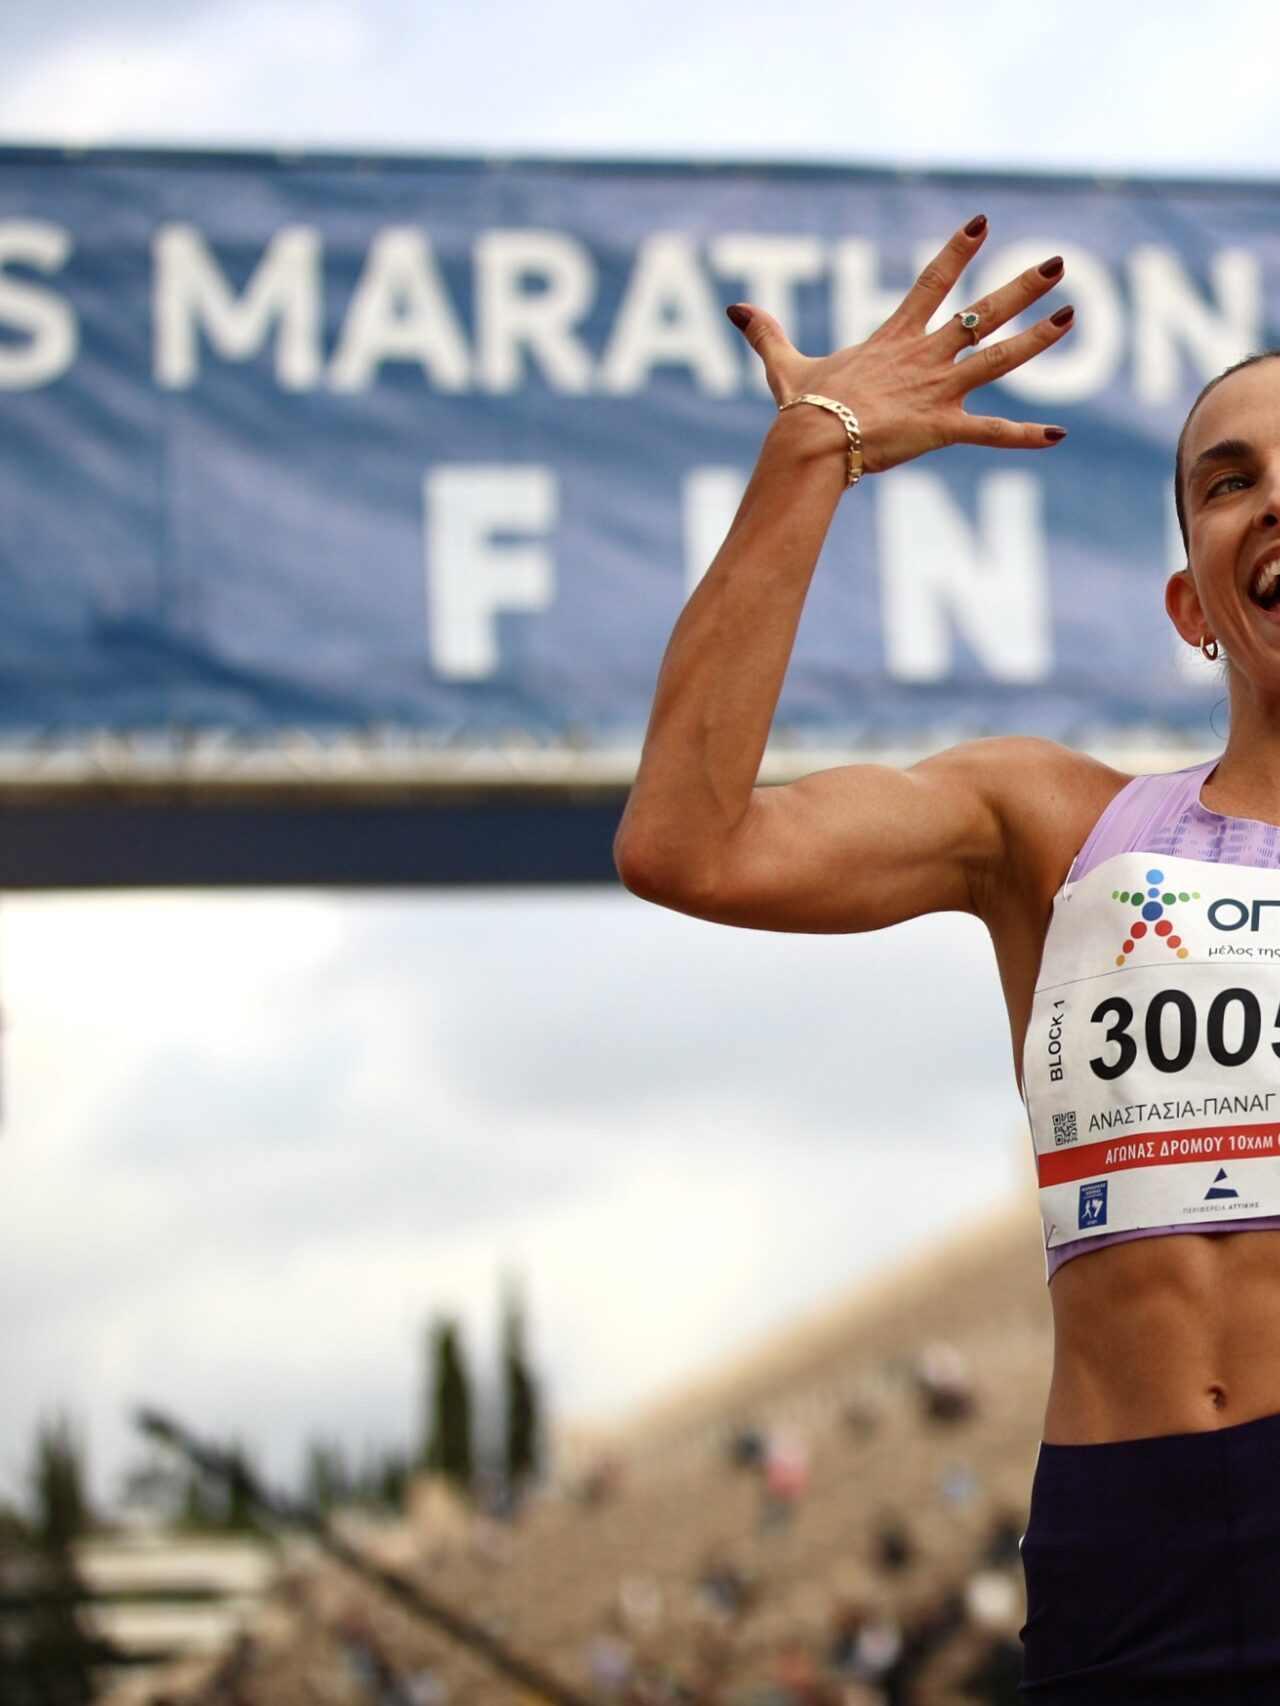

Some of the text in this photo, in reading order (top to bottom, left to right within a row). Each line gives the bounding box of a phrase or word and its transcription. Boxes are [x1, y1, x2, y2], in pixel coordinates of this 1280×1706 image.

[1208, 945, 1253, 958] μέλος
[1048, 1000, 1065, 1081] BLOCK 1
[1089, 1093, 1276, 1132] ΑΝΑΣΤΑΣΙΑ-ΠΑΝΑΓ
[1105, 1141, 1155, 1164] ΑΓΩΝΑΣ
[1160, 1136, 1223, 1157] ΔΡΟΜΟΥ
